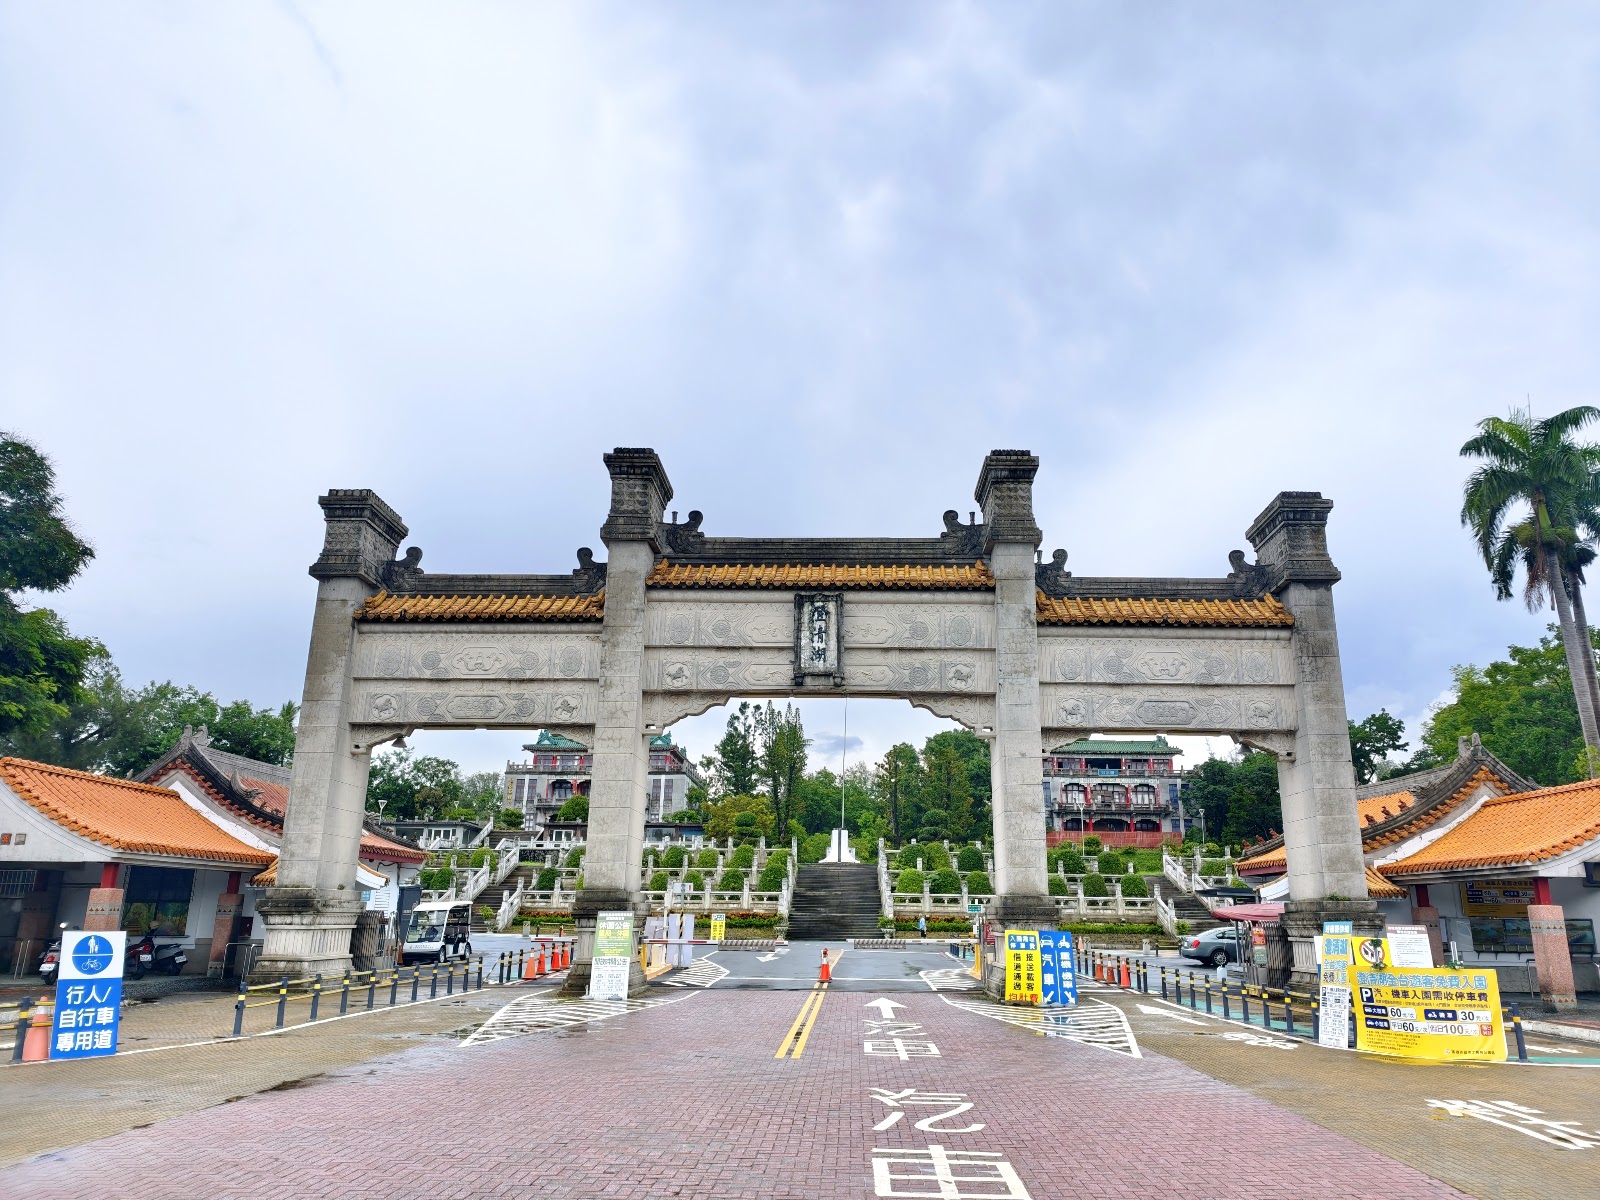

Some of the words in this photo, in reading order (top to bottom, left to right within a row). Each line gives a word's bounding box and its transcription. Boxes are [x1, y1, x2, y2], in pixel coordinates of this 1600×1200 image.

[1042, 953, 1055, 986] 汽車
[66, 985, 112, 1005] 行人/
[59, 1007, 114, 1029] 自行車
[56, 1030, 112, 1052] 專用道
